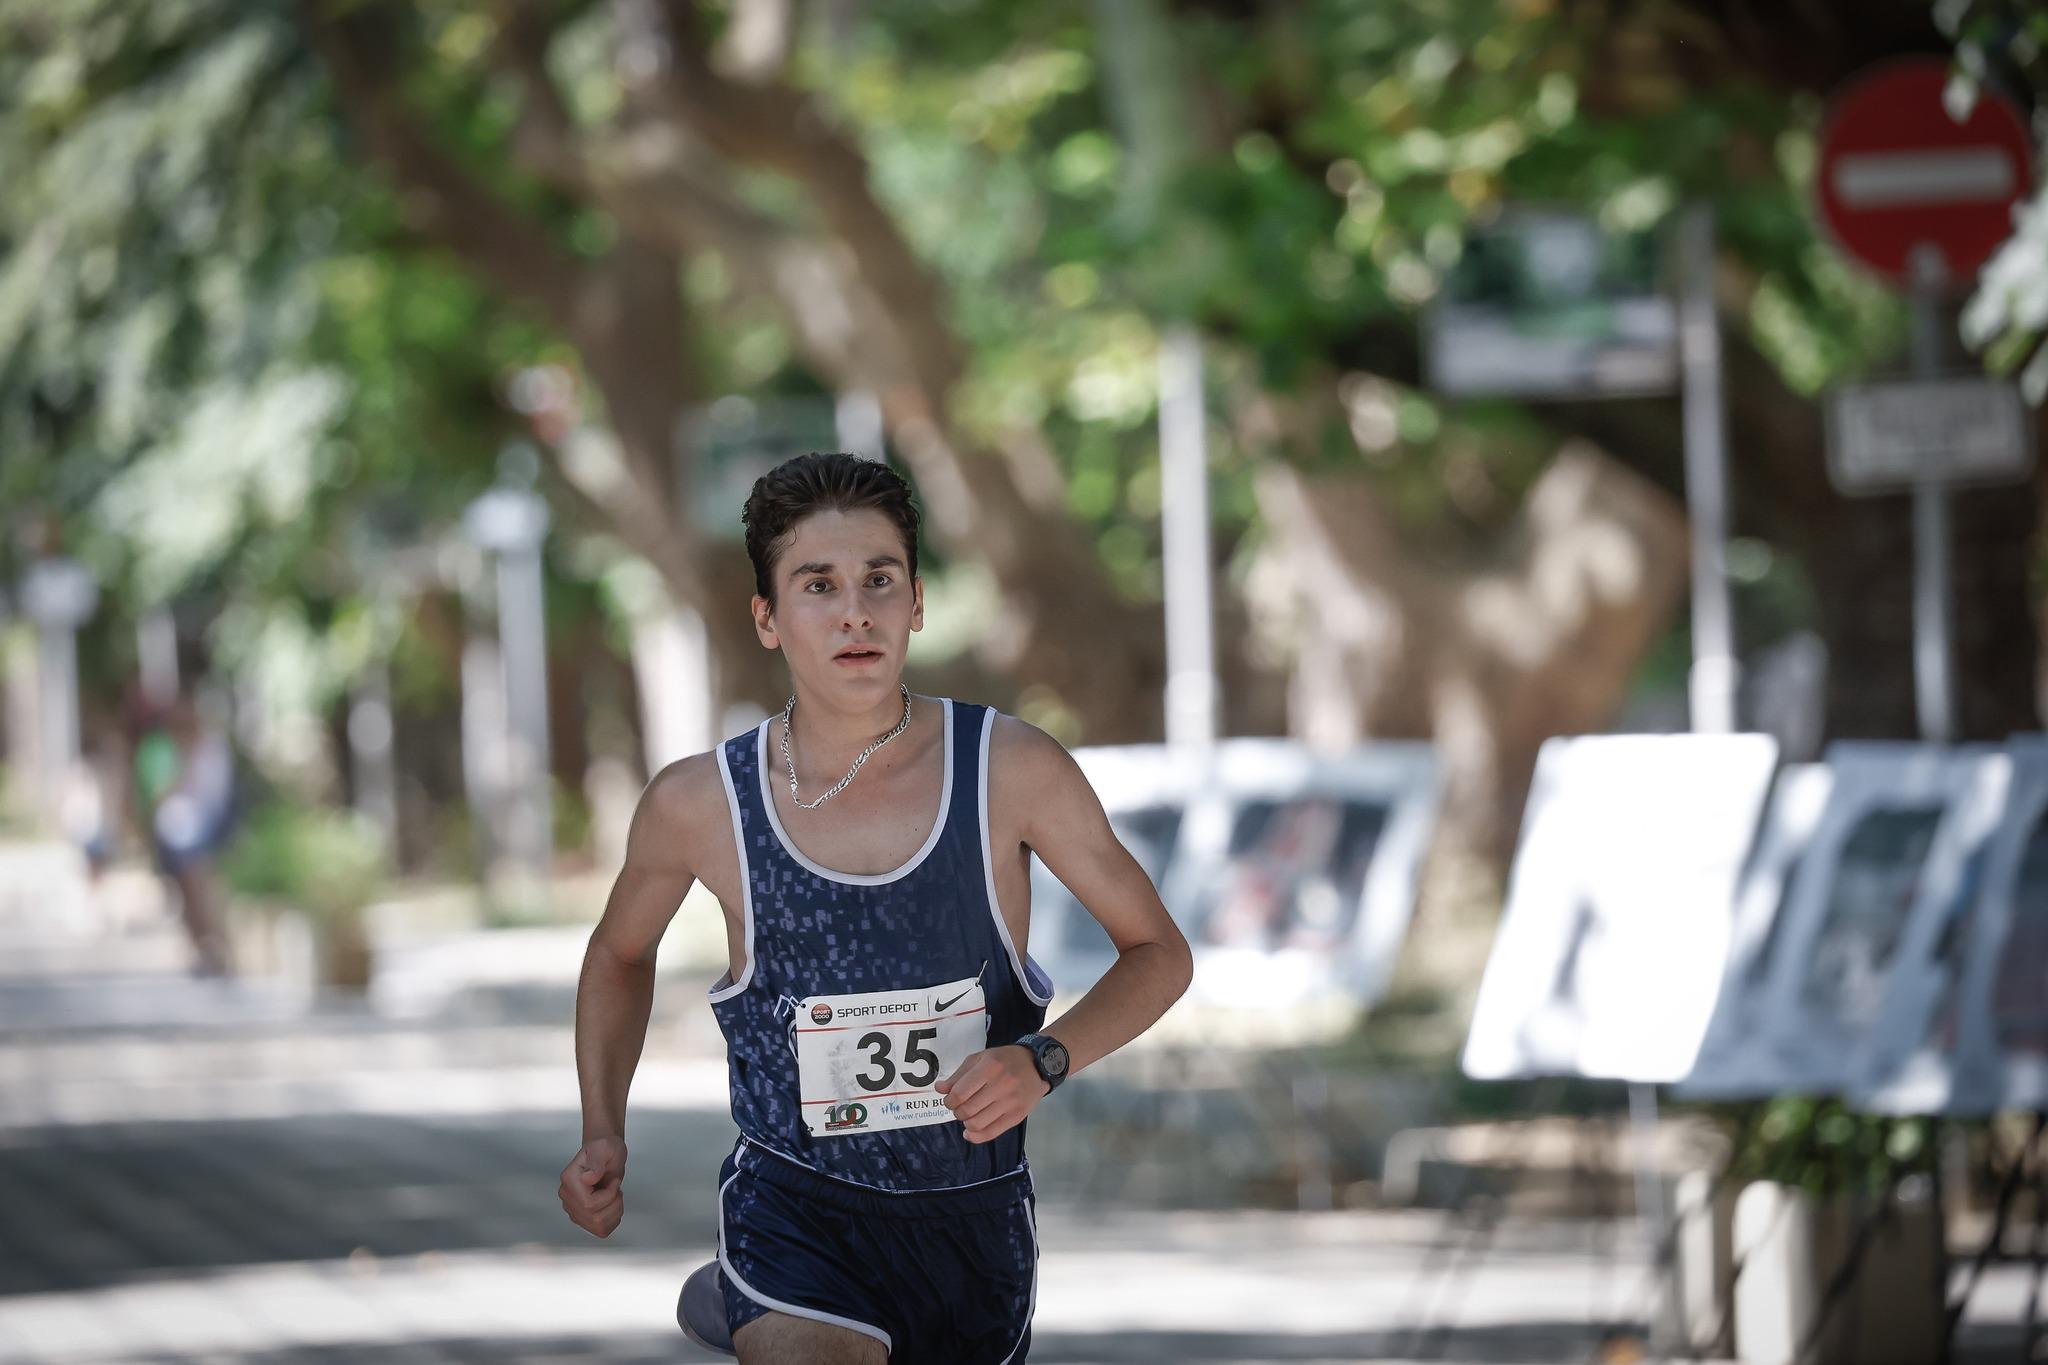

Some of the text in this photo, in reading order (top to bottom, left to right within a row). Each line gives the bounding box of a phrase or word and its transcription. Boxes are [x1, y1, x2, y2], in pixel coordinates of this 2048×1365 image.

[837, 1003, 919, 1018] SPORT DEPOT
[855, 1027, 940, 1092] 35
[906, 1098, 945, 1110] RUN BU
[895, 1109, 951, 1121] www.runbulga
